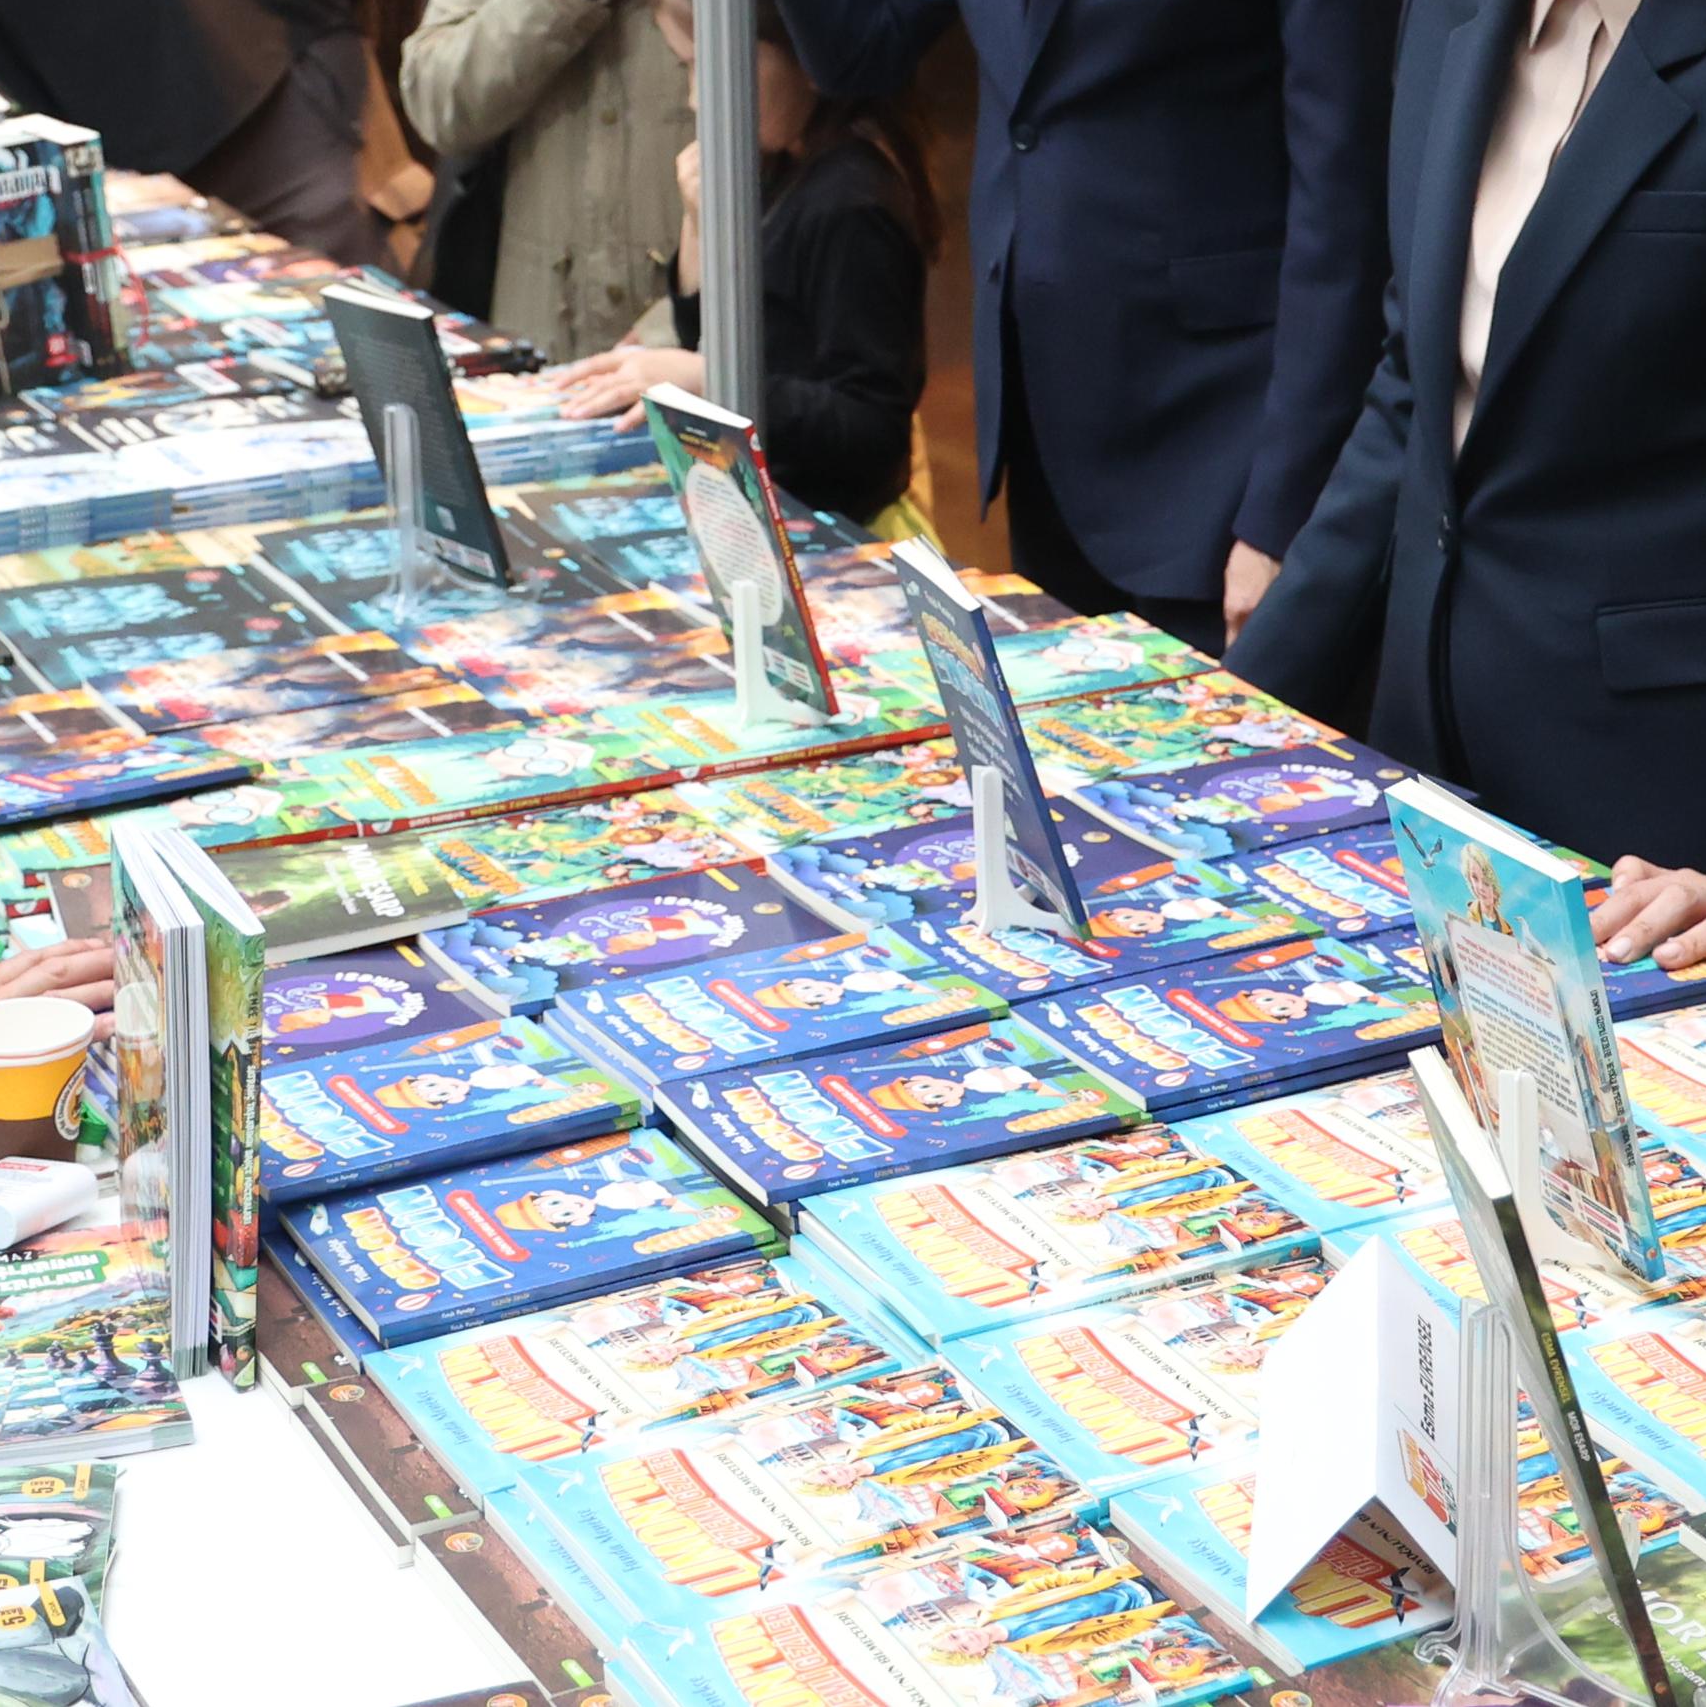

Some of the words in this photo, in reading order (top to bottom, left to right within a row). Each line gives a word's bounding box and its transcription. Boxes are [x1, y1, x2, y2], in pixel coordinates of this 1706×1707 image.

[1101, 984, 1256, 1069] ENGİN
[752, 1070, 895, 1163] ENGİN
[342, 1206, 441, 1290] GEZGİN
[377, 1184, 515, 1290] ENGİN
[1417, 1314, 1434, 1392] EVRENSEL
[1541, 1333, 1556, 1357] ESMA
[1549, 1357, 1571, 1404] EVRENSEL
[1420, 1391, 1436, 1442] Esma
[1566, 1410, 1580, 1431] MOR
[1572, 1430, 1591, 1462] EŞARP
